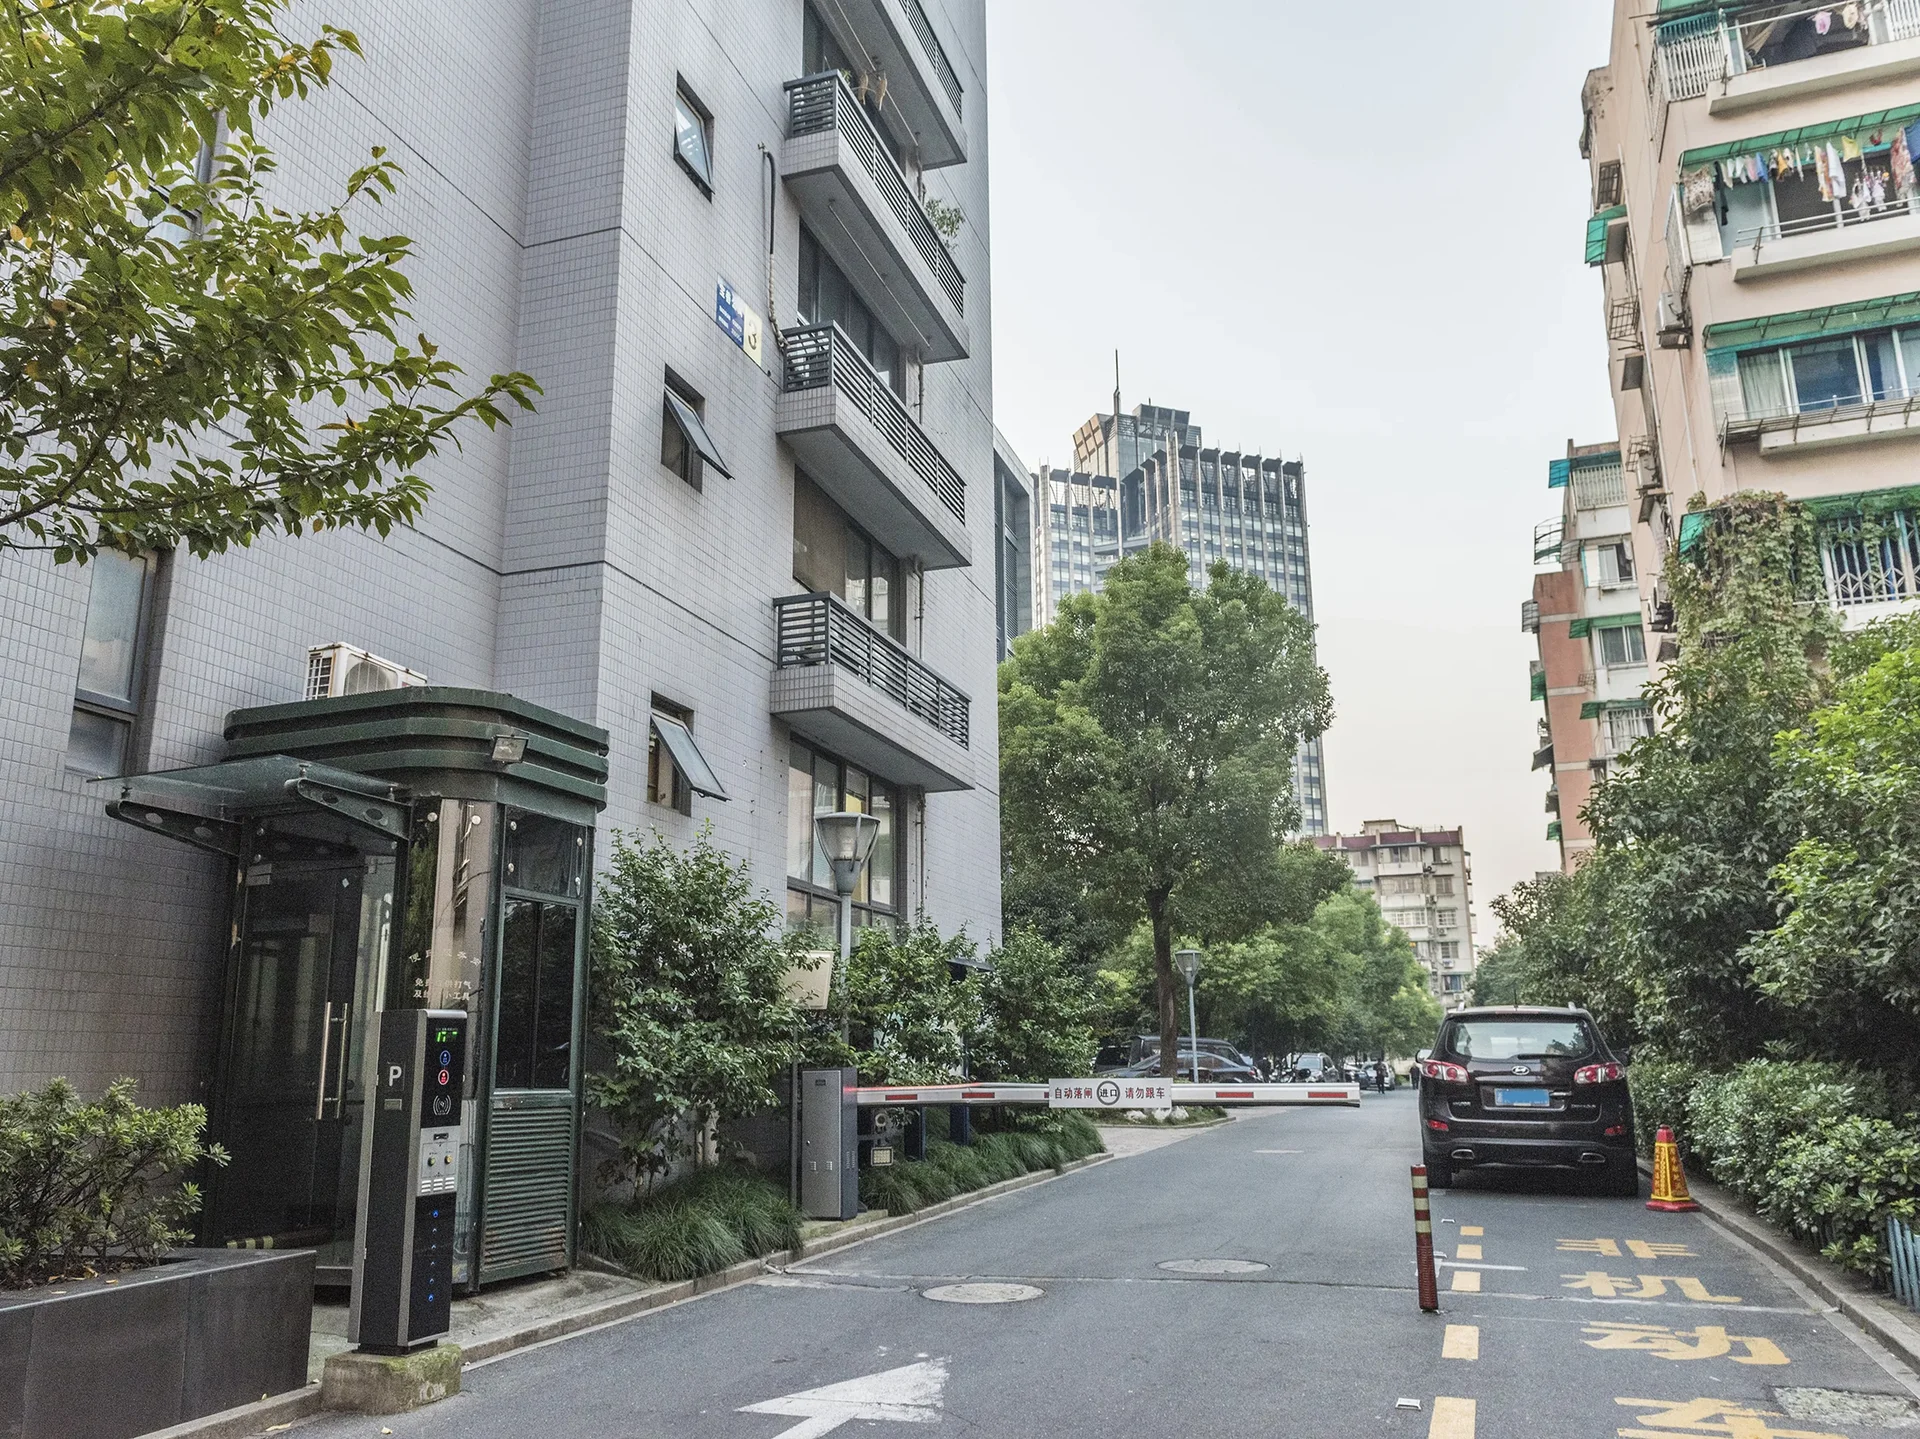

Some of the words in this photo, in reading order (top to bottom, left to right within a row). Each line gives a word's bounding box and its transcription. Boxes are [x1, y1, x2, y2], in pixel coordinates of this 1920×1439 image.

[388, 1065, 402, 1087] P
[1054, 1087, 1093, 1099] 自动落闸
[1099, 1088, 1118, 1098] 进口
[1125, 1087, 1166, 1099] 请勿跟车
